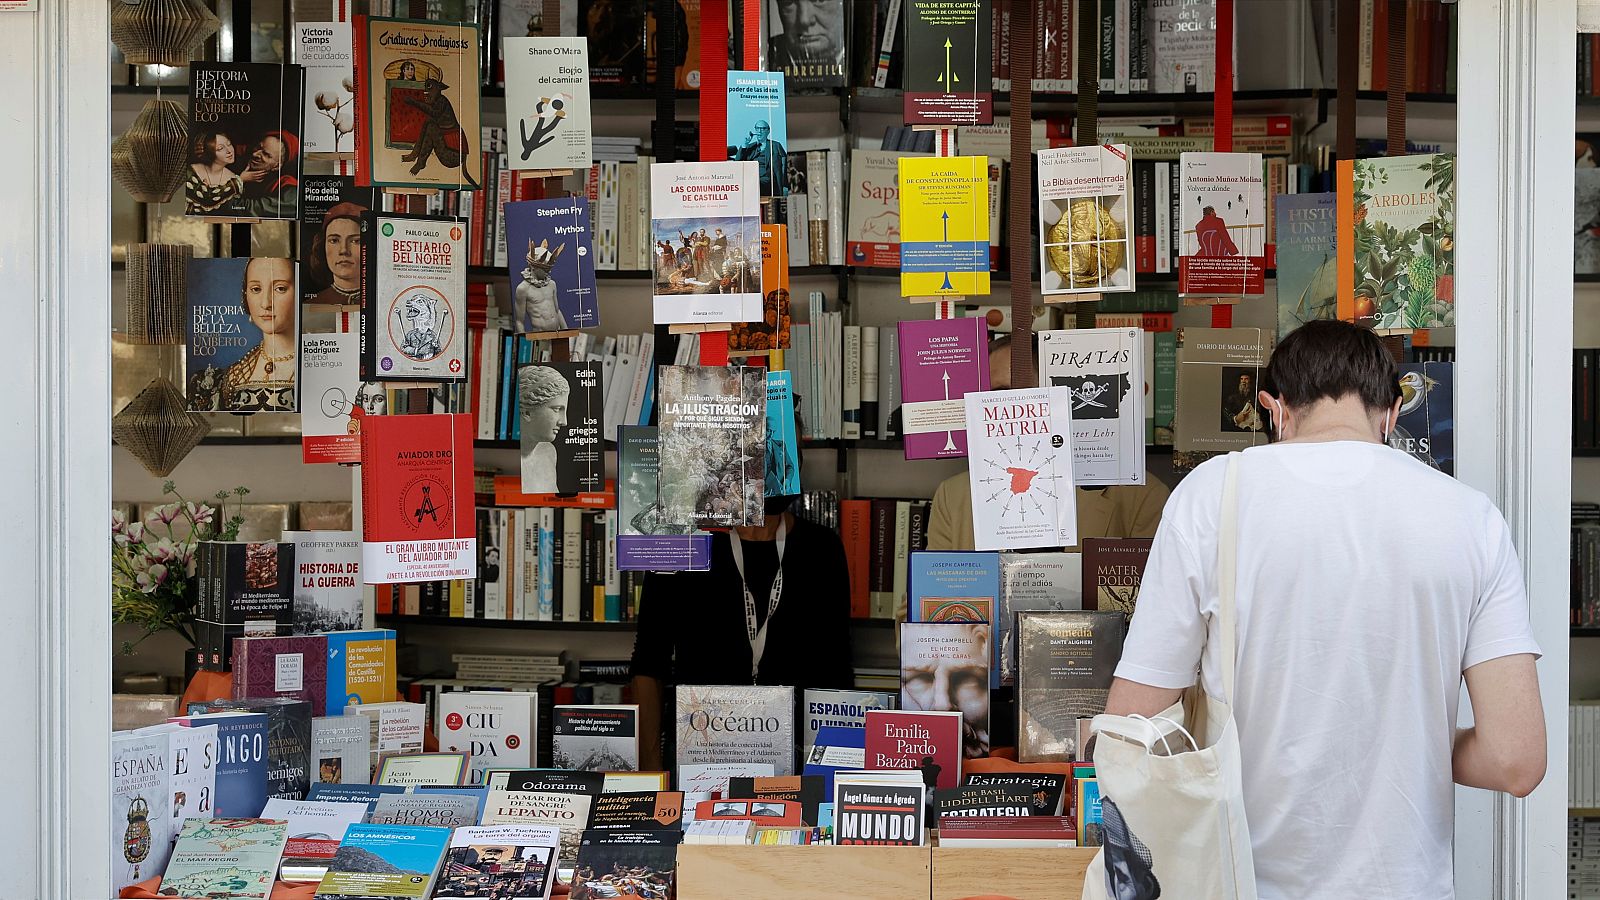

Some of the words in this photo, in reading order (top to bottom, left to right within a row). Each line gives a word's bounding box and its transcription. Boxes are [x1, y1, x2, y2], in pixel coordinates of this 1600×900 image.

[302, 37, 329, 45] Camps
[380, 31, 418, 45] Criaturas
[420, 33, 468, 50] Prodigiosas
[1104, 16, 1114, 60] ANARQUÍA
[302, 45, 331, 53] Tiempo
[559, 67, 582, 75] Elogio
[777, 65, 843, 76] CHURCHILL
[196, 71, 248, 81] HISTORIA
[196, 89, 250, 99] FEALDAD
[196, 104, 250, 114] UMBERTO
[195, 112, 218, 122] ECO
[866, 157, 886, 165] Yuval
[1053, 178, 1072, 186] Biblia
[1074, 174, 1124, 184] desenterrada
[687, 185, 739, 193] COMUNIDADES
[1372, 192, 1436, 208] ÁRBOLES
[537, 208, 569, 217] Stephen
[571, 207, 582, 215] Fry
[555, 225, 584, 235] Mythos
[393, 241, 451, 253] BESTIARIO
[393, 252, 413, 263] DEL
[416, 253, 451, 265] NORTE
[193, 306, 244, 315] HISTORIA
[193, 324, 241, 333] BELLEZA
[304, 346, 339, 354] Rodríguez
[1050, 350, 1129, 368] PIRATAS
[576, 370, 596, 378] Edith
[581, 379, 596, 387] Hall
[684, 394, 714, 402] Anthony
[716, 394, 740, 403] Pagden
[666, 404, 679, 414] LA
[684, 404, 759, 415] ILUSTRACIÓN
[983, 403, 1050, 421] MADRE
[569, 427, 597, 436] griegos
[986, 420, 1049, 437] PATRIA
[565, 436, 598, 445] antiguos
[398, 451, 433, 459] AVIADOR
[436, 450, 453, 458] DRO
[912, 514, 921, 547] KUKSO
[386, 545, 395, 553] EL
[396, 544, 415, 553] GRAN
[416, 543, 436, 552] LIBRO
[438, 541, 469, 551] MUTANTE
[300, 563, 343, 573] HISTORIA
[347, 563, 358, 573] DE
[1098, 565, 1139, 575] MATER
[302, 578, 314, 587] LA
[318, 577, 355, 587] GUERRA
[1050, 627, 1092, 637] comedia
[349, 676, 382, 684] (1520-1521)
[466, 713, 502, 729] CIU
[690, 710, 779, 732] Océano
[231, 723, 263, 731] REYBROUCK
[885, 724, 930, 739] Emilia
[471, 741, 497, 756] DA
[897, 740, 936, 755] Pardo
[114, 754, 164, 777] ESPAÑA
[876, 754, 917, 768] Bazán
[522, 782, 586, 791] Odorama
[597, 796, 654, 804] Inteligencia
[844, 791, 861, 803] Ángel
[863, 793, 883, 803] Gómez
[885, 794, 892, 803] de
[893, 792, 915, 805] Ágreda
[941, 798, 993, 808] LIDDELL
[996, 795, 1029, 803] HART
[397, 809, 454, 817] HOMO
[498, 808, 574, 819] LEPANTO
[658, 808, 676, 817] 50
[941, 807, 1029, 817] ESTRATEGIA
[384, 817, 461, 825] BELLICUS
[842, 814, 914, 839] MUNDO
